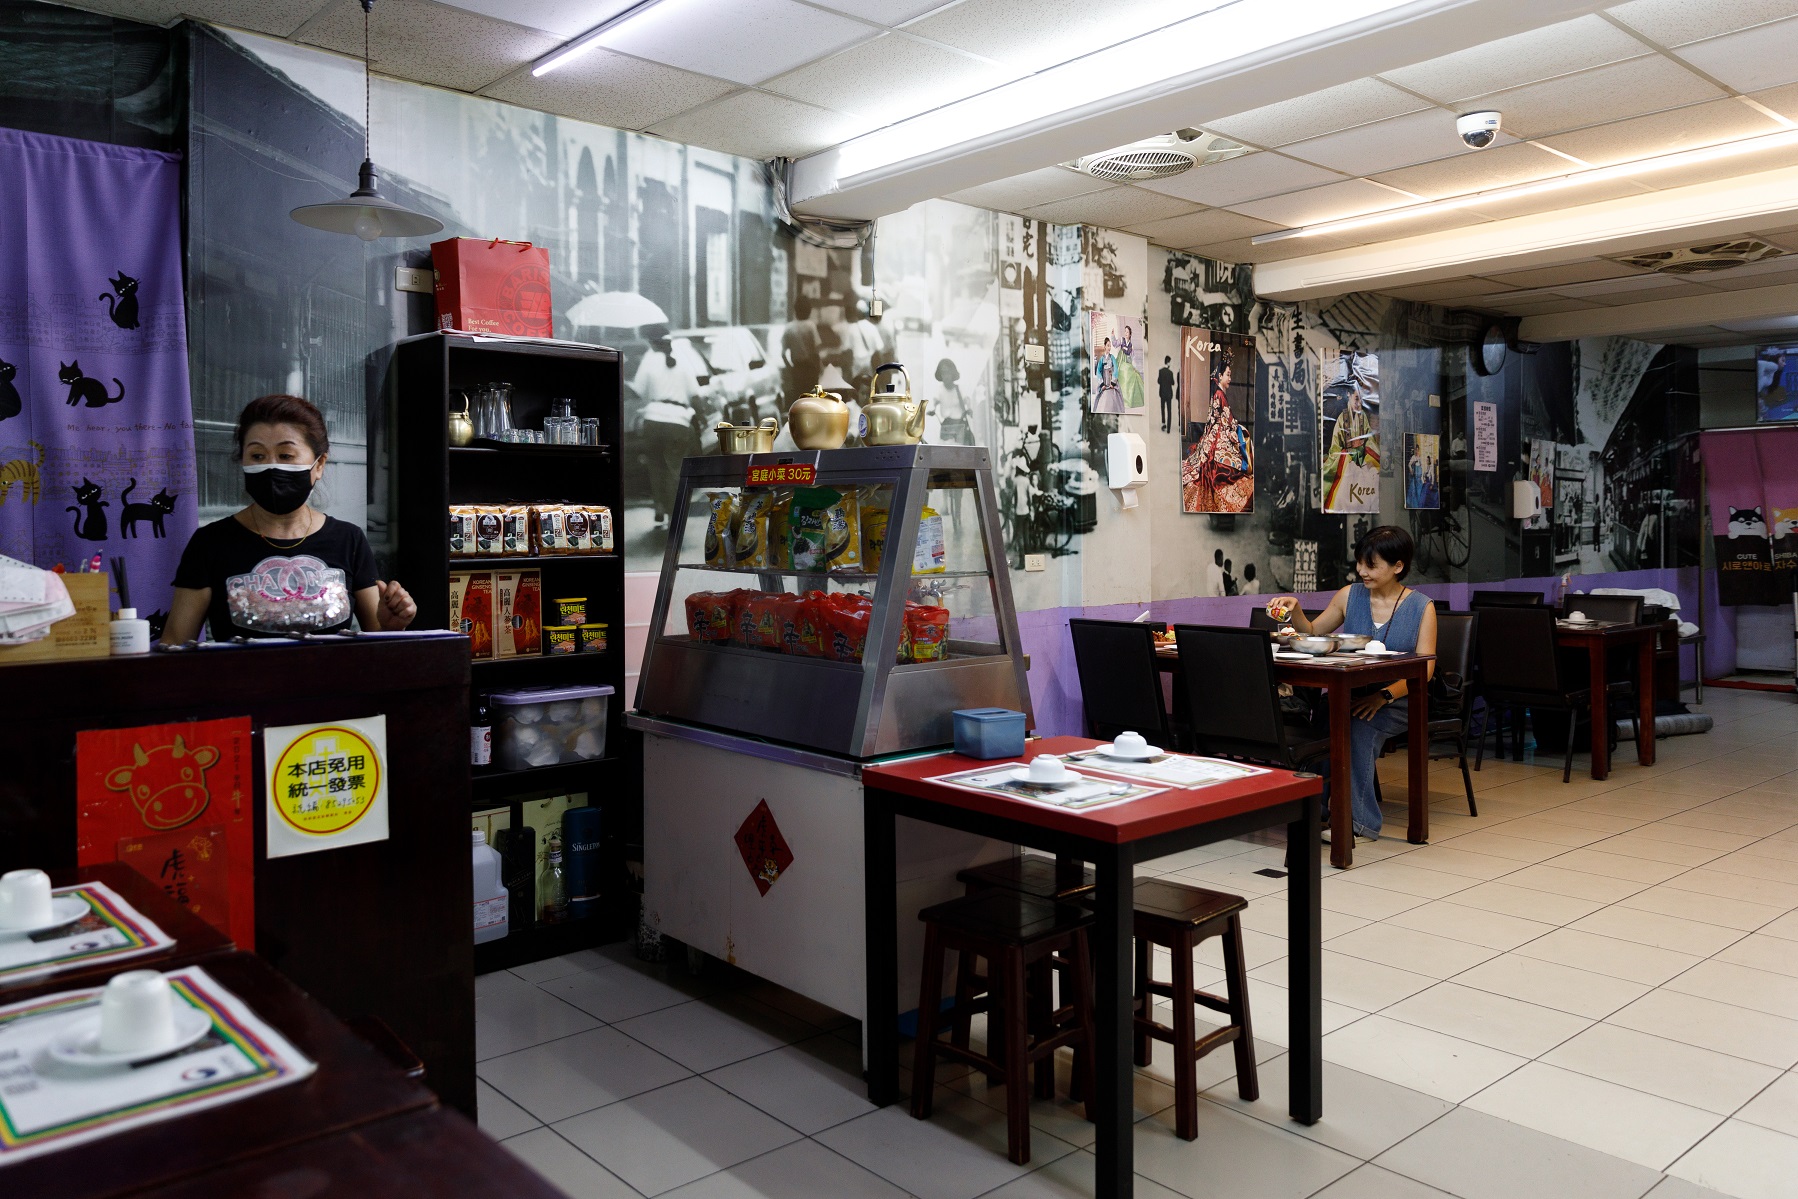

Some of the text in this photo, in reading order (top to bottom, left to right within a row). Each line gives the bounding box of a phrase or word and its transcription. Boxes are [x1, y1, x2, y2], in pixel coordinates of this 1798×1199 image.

[467, 317, 500, 326] Best Coffee
[1185, 335, 1222, 361] Korea
[164, 422, 176, 430] No
[751, 467, 811, 482] 宮庭小菜 30元
[1349, 483, 1376, 505] Korea
[450, 590, 460, 632] 高麗人蔘
[692, 608, 710, 644] 辛
[740, 609, 757, 648] 辛
[782, 619, 801, 656] 辛
[287, 755, 365, 778] 本店免用
[287, 773, 366, 799] 統一發票
